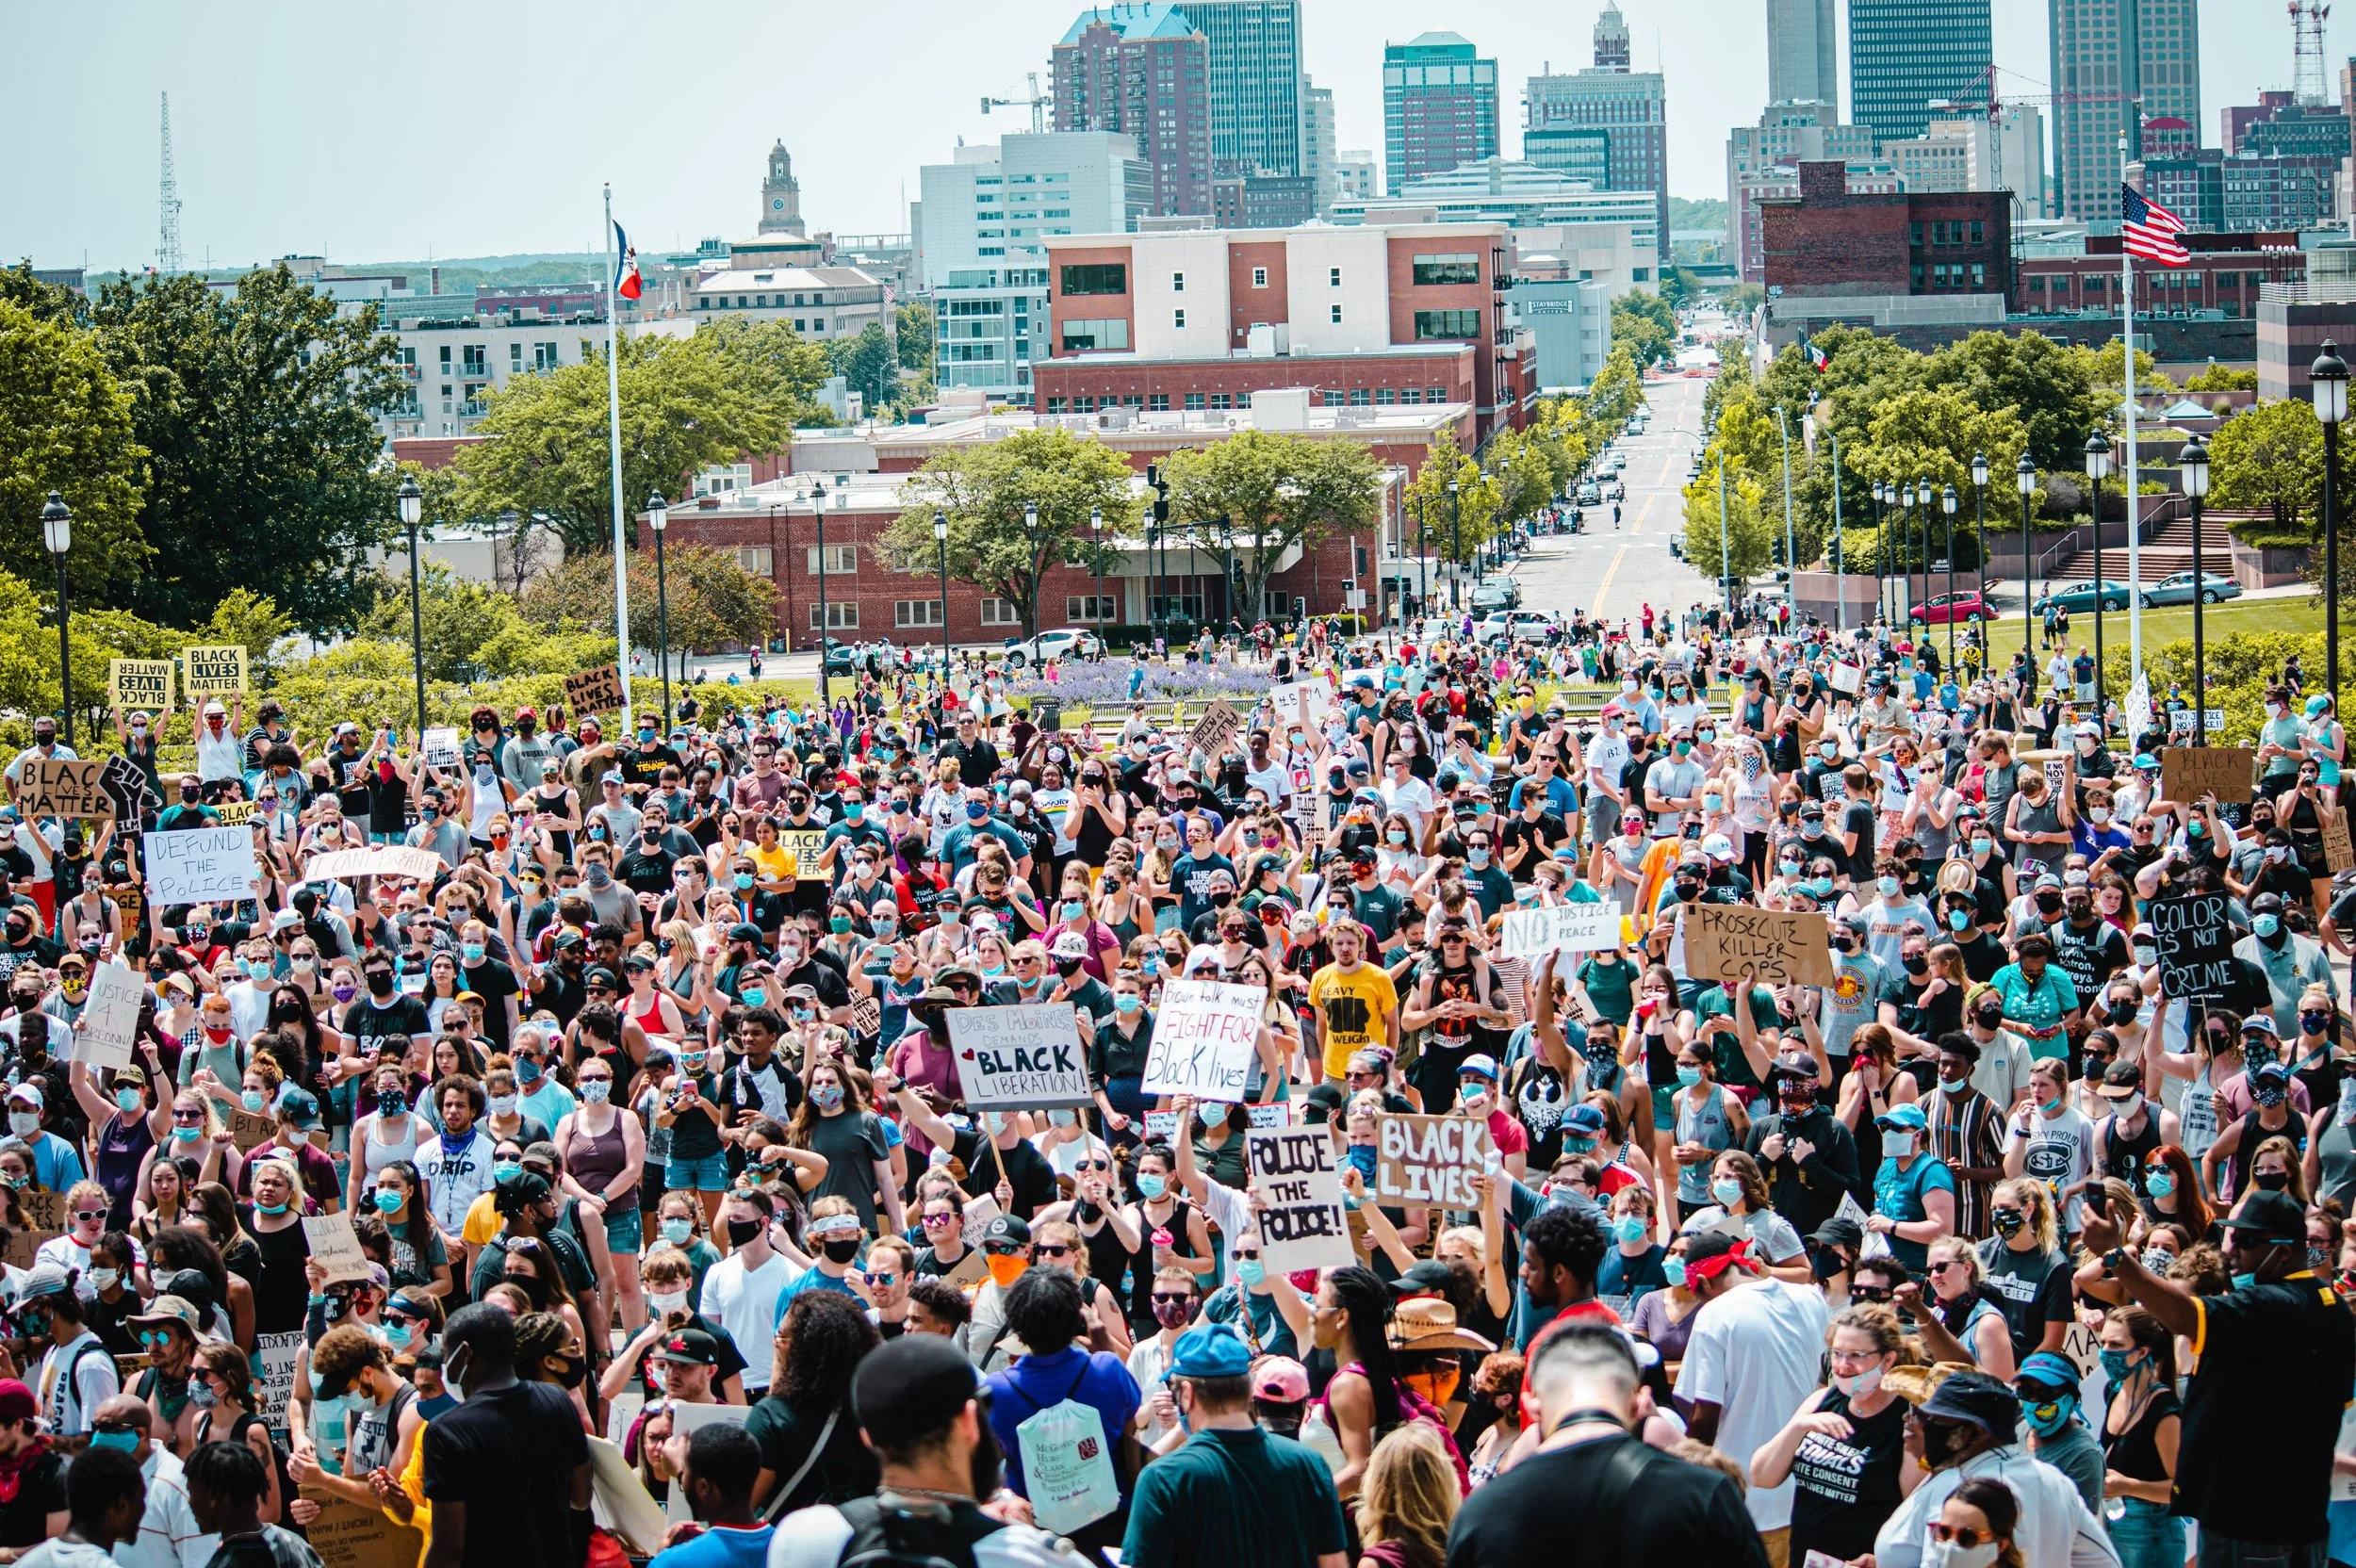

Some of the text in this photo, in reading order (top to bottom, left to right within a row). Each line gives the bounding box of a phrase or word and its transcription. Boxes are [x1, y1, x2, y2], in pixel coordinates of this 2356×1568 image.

[191, 649, 237, 662] BLACK
[120, 663, 168, 675] MATTER
[193, 664, 236, 677] LIVES
[121, 677, 165, 690] LIVES
[190, 678, 238, 690] MATTER
[566, 668, 614, 693] BLACK
[120, 691, 166, 704] BLACK
[571, 684, 614, 705] LIVES
[574, 695, 627, 718] MATTER
[1217, 709, 1226, 720] IS
[2190, 711, 2220, 721] JTICE
[428, 751, 456, 765] MATTER
[2181, 751, 2239, 771] BLACK
[24, 763, 95, 787] BLAC
[2177, 771, 2232, 787] LIVES
[42, 785, 92, 796] LIVES
[21, 793, 110, 814] MATTER
[220, 805, 256, 821] BLAC
[116, 819, 141, 832] BLM
[155, 831, 242, 860] DEFUND
[777, 834, 824, 848] LACK
[183, 858, 218, 874] THE
[312, 855, 322, 876] I
[378, 852, 435, 873] BREATHE
[1191, 871, 1210, 879] THE
[915, 888, 933, 896] YOUNG
[2152, 897, 2226, 933] COLOR
[1509, 903, 1611, 952] NO JUSTICE
[1559, 925, 1596, 939] PEACE
[1701, 907, 1808, 946] PROSECUTE
[1719, 938, 1797, 959] KILLER
[2153, 927, 2220, 956] IS NOT
[1721, 958, 1787, 978] COPS
[2160, 957, 2175, 972] A
[2074, 982, 2104, 993] mond
[2164, 960, 2235, 996] CRIME
[93, 974, 141, 1006] JUSTICE
[1165, 980, 1262, 1011] Brown folk must
[1319, 987, 1355, 997] HEAVY
[98, 1003, 112, 1027] 4
[955, 1011, 999, 1035] DES
[1165, 1011, 1256, 1043] FIGHT FOR
[79, 1028, 133, 1047] BREONNA
[982, 1033, 1043, 1046] DEMANDS
[1333, 1034, 1370, 1045] WEIGHT
[977, 1044, 1076, 1075] BLACK
[1208, 1044, 1245, 1087] lives
[1788, 1052, 1798, 1065] B
[974, 1068, 1087, 1098] LIBERATION!
[236, 1115, 277, 1135] BLAC
[1382, 1119, 1484, 1166] BLACK
[2052, 1131, 2079, 1147] PROUD
[1250, 1135, 1334, 1177] POLICE
[428, 1160, 476, 1178] DRIP
[1268, 1180, 1312, 1202] THE
[1380, 1162, 1481, 1208] LIVES
[26, 1195, 55, 1211] ACK
[1257, 1204, 1342, 1247] POLICE!
[1795, 1437, 1865, 1475] EQUALS
[1794, 1462, 1811, 1476] HITE
[1812, 1467, 1859, 1489] CONSENT
[1806, 1481, 1824, 1494] LIVES
[1824, 1488, 1857, 1503] MATTER
[342, 1518, 374, 1530] FRONT
